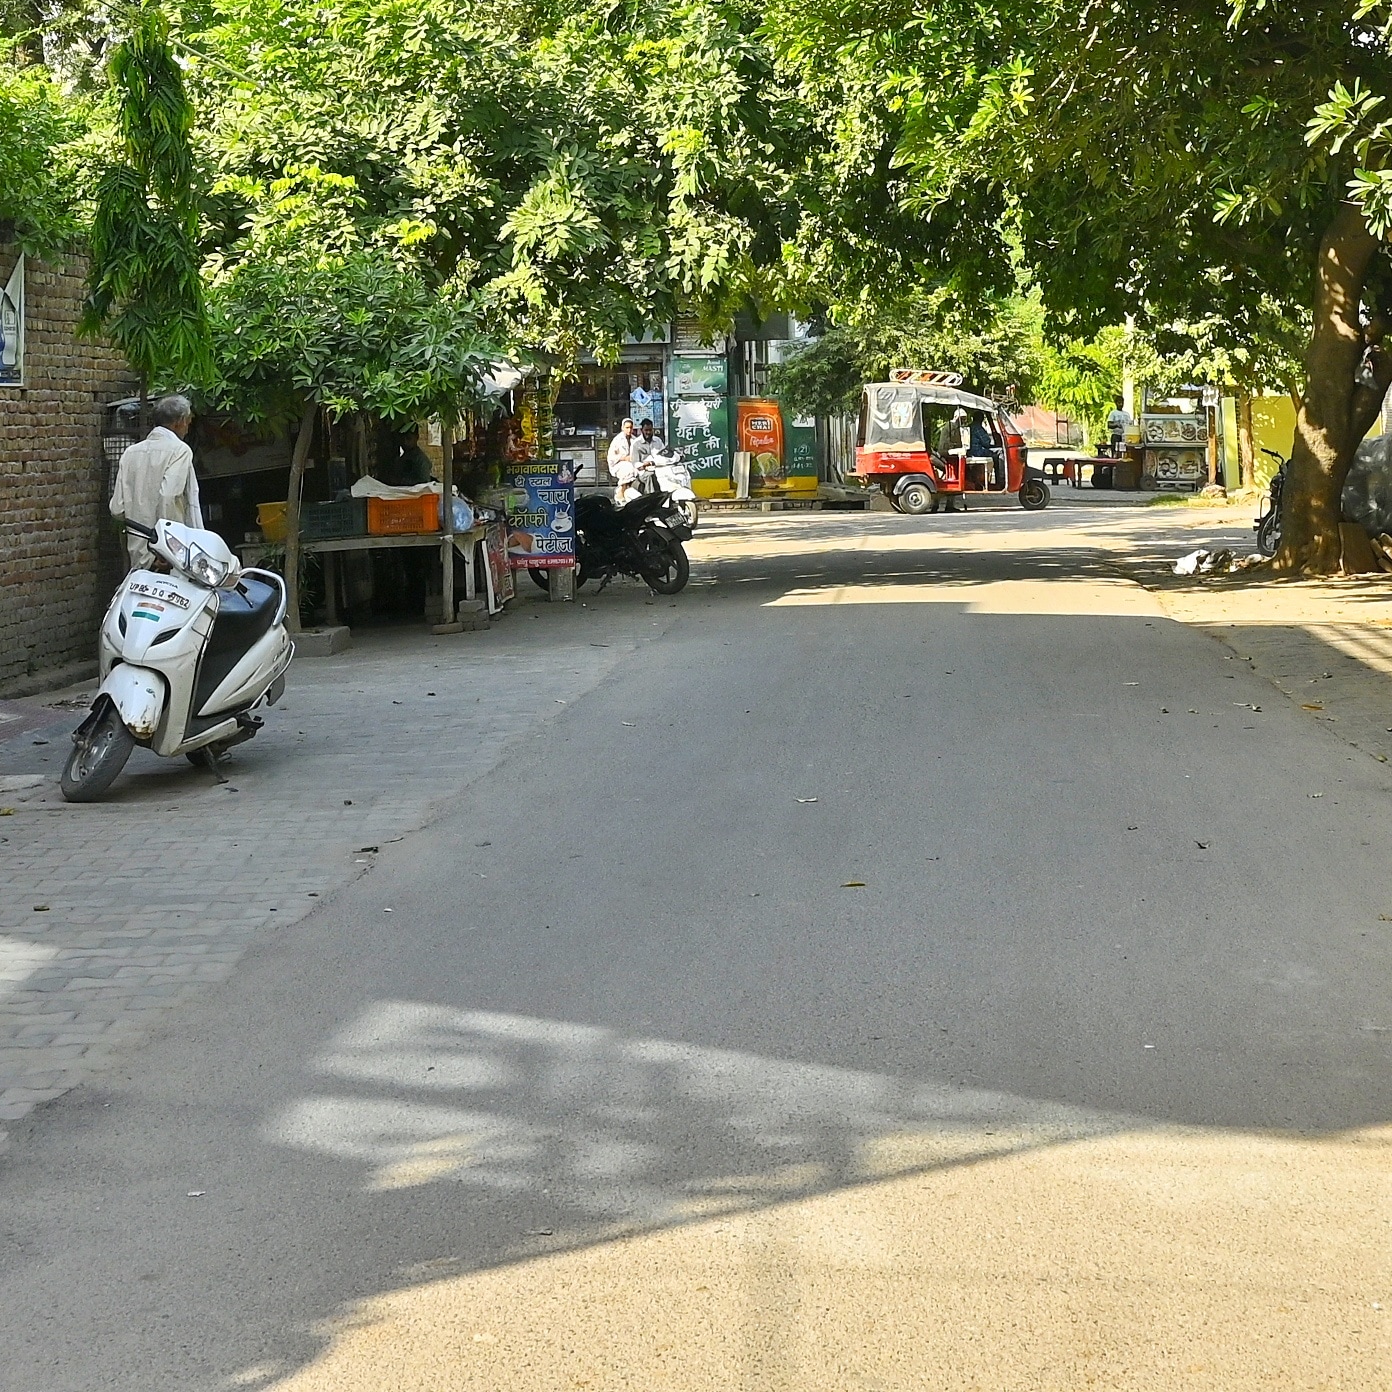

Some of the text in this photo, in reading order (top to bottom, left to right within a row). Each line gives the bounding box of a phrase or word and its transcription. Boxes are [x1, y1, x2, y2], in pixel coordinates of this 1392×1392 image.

[703, 435, 721, 452] की
[506, 464, 558, 475] भगवानदास
[537, 489, 569, 504] चाय
[508, 508, 549, 528] कॉफी
[535, 531, 573, 553] पेटीज
